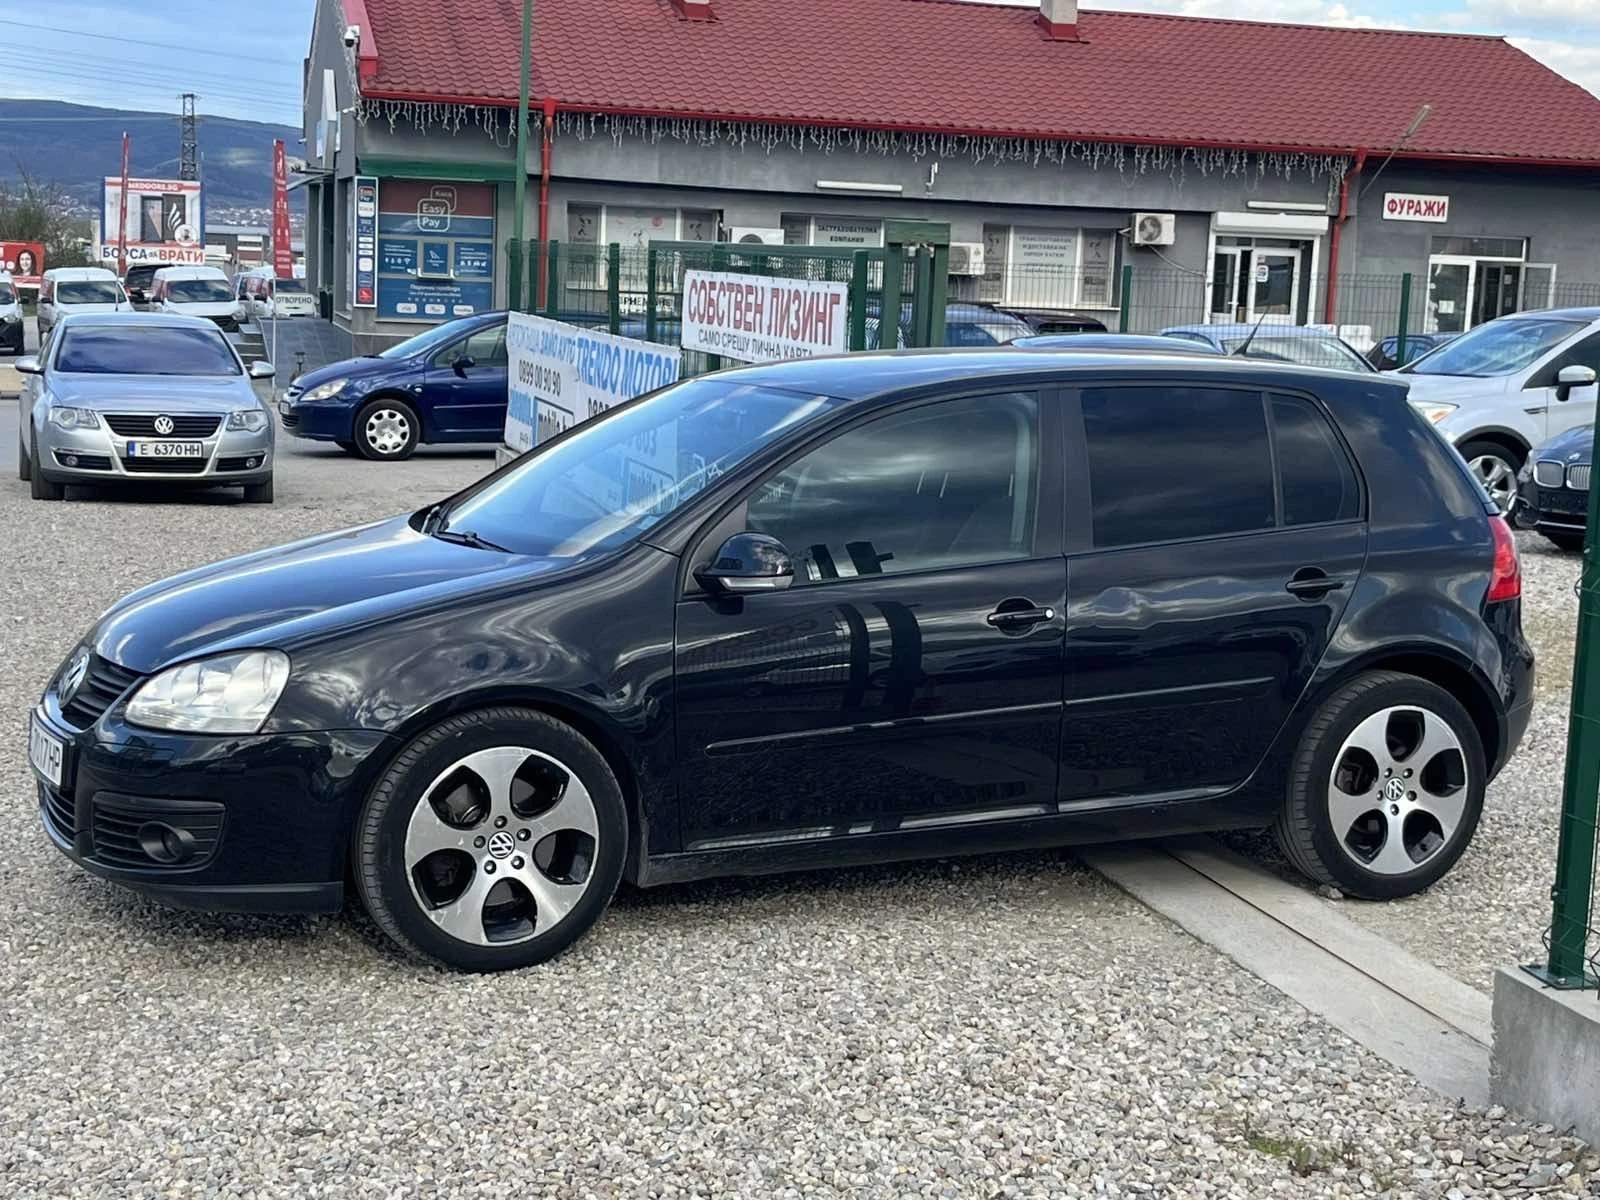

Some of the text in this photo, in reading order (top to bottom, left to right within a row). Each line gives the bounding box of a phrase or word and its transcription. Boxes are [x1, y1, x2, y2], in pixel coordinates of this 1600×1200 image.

[422, 203, 446, 216] Easy
[1387, 198, 1446, 217] ФУРАЖИ
[422, 217, 440, 228] Pay
[159, 249, 204, 262] ВРАТИ
[275, 296, 312, 304] ОТВОРЕНО
[688, 279, 841, 346] СОБСТВЕН ЛИЗИНГ
[698, 329, 721, 347] САМО
[721, 331, 751, 353] СРЕЩУ
[751, 338, 782, 359] ЛИЧНА
[577, 337, 620, 394] TRENDO
[140, 444, 200, 456] E 6370HH
